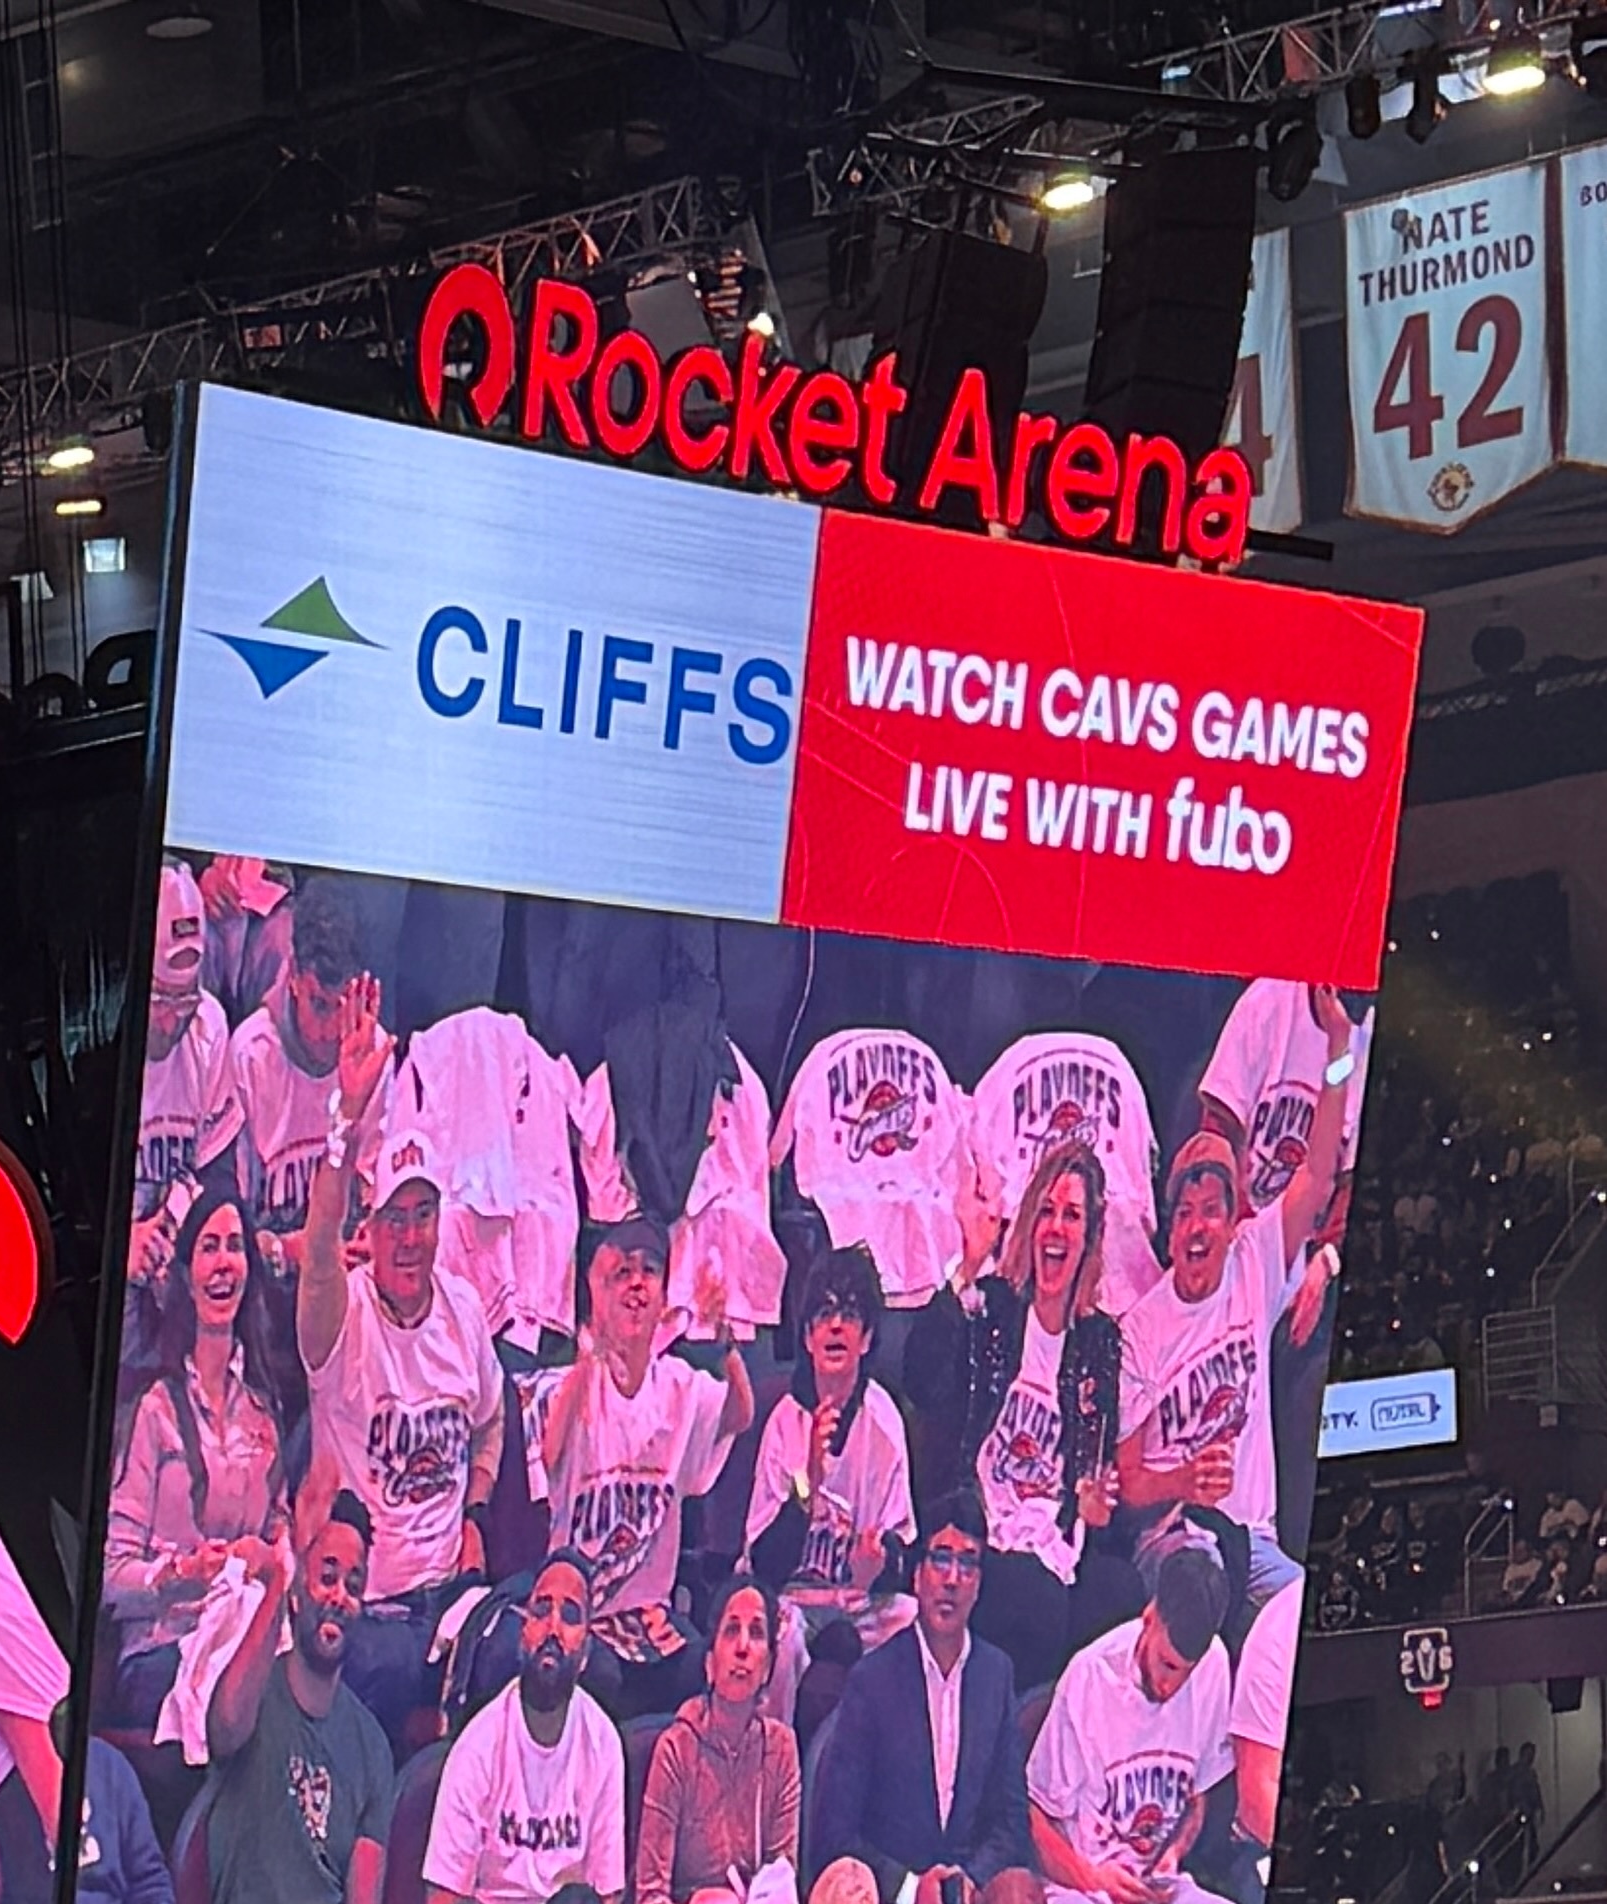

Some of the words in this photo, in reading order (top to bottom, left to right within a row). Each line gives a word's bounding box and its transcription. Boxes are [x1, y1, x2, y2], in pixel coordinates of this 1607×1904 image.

[1359, 233, 1536, 309] THURMOND
[1402, 200, 1492, 254] NATE
[523, 277, 908, 503] Rocket
[919, 367, 1254, 566] Arena
[1373, 295, 1525, 462] 42
[417, 604, 793, 766] CLIFFS
[845, 635, 1027, 730] WATCH
[1040, 666, 1181, 753] CAVS
[1191, 690, 1370, 779] GAMES
[904, 763, 1013, 842] LIVE
[1026, 778, 1152, 861] WITH
[1166, 777, 1293, 876] fubo
[827, 1044, 938, 1119] PLAYOFFS
[1013, 1061, 1123, 1137] PLAYOFFS
